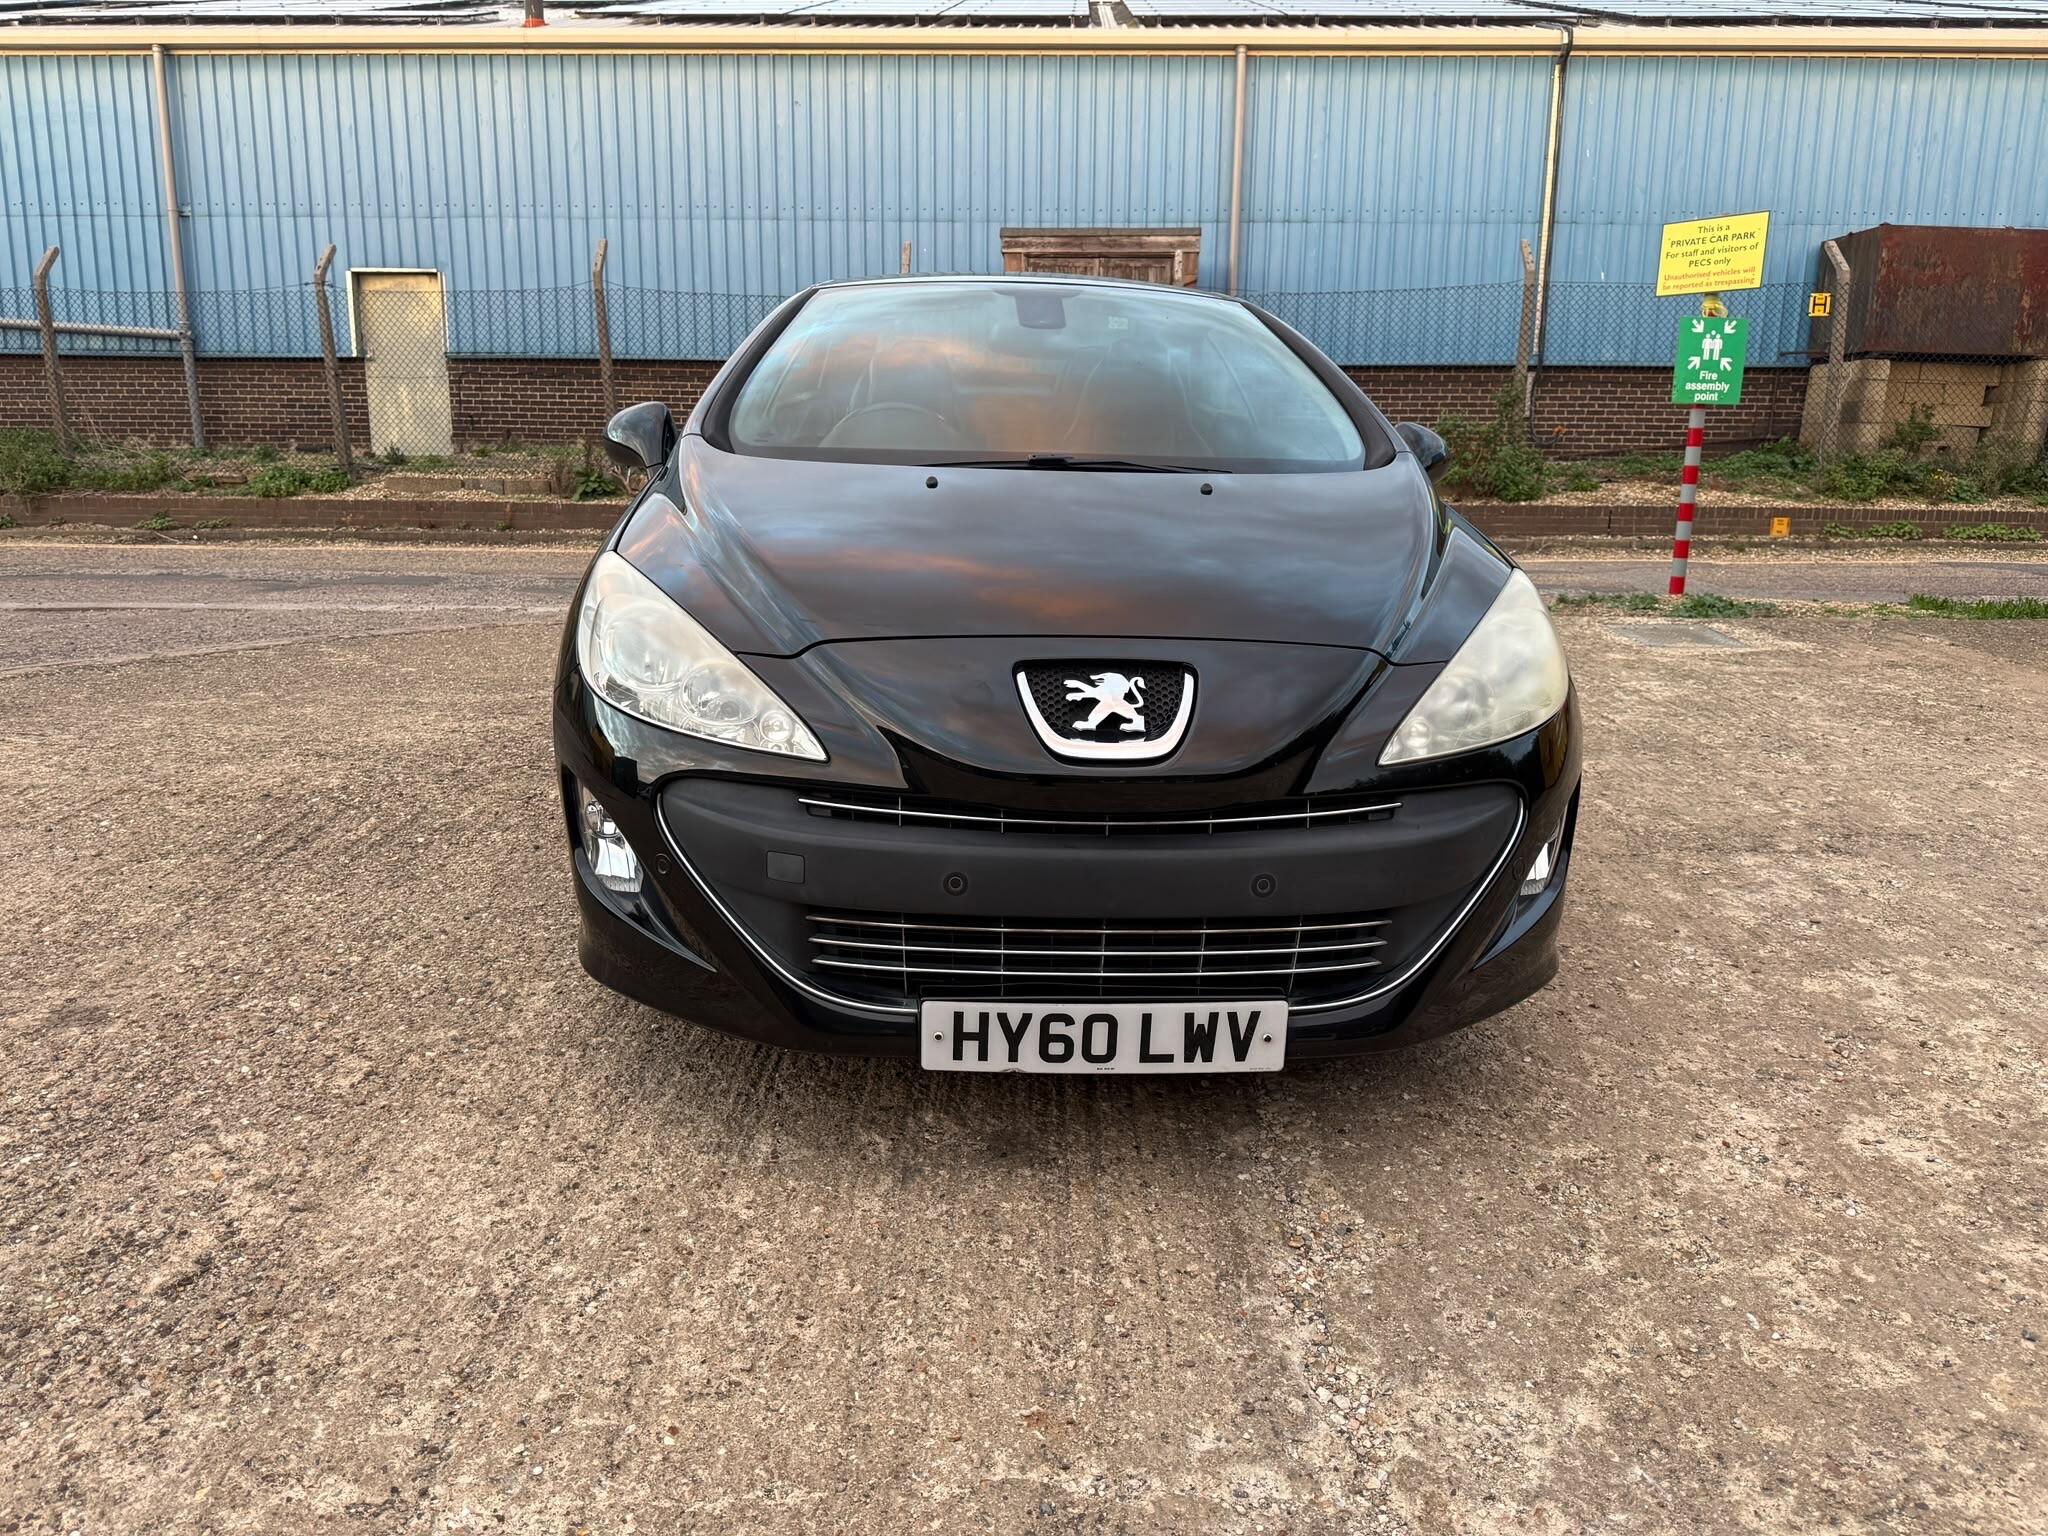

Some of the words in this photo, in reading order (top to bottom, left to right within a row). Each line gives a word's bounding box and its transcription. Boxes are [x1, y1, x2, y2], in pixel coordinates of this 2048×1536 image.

[1698, 225, 1714, 233] This
[1671, 237, 1707, 247] PRIVATE
[1709, 235, 1728, 243] CAR
[1732, 232, 1755, 240] PARK
[1682, 249, 1698, 258] staff
[1718, 244, 1746, 253] visitors
[1689, 259, 1711, 267] PECS
[1714, 257, 1731, 266] only
[1664, 272, 1711, 280] Unauthorised
[1673, 281, 1703, 290] reported
[1715, 277, 1755, 286] trespassing
[1700, 371, 1718, 380] Fire
[1685, 382, 1730, 393] assembly
[1694, 392, 1718, 402] point
[952, 1010, 1118, 1064] HY60
[1139, 1010, 1261, 1063] LWV
